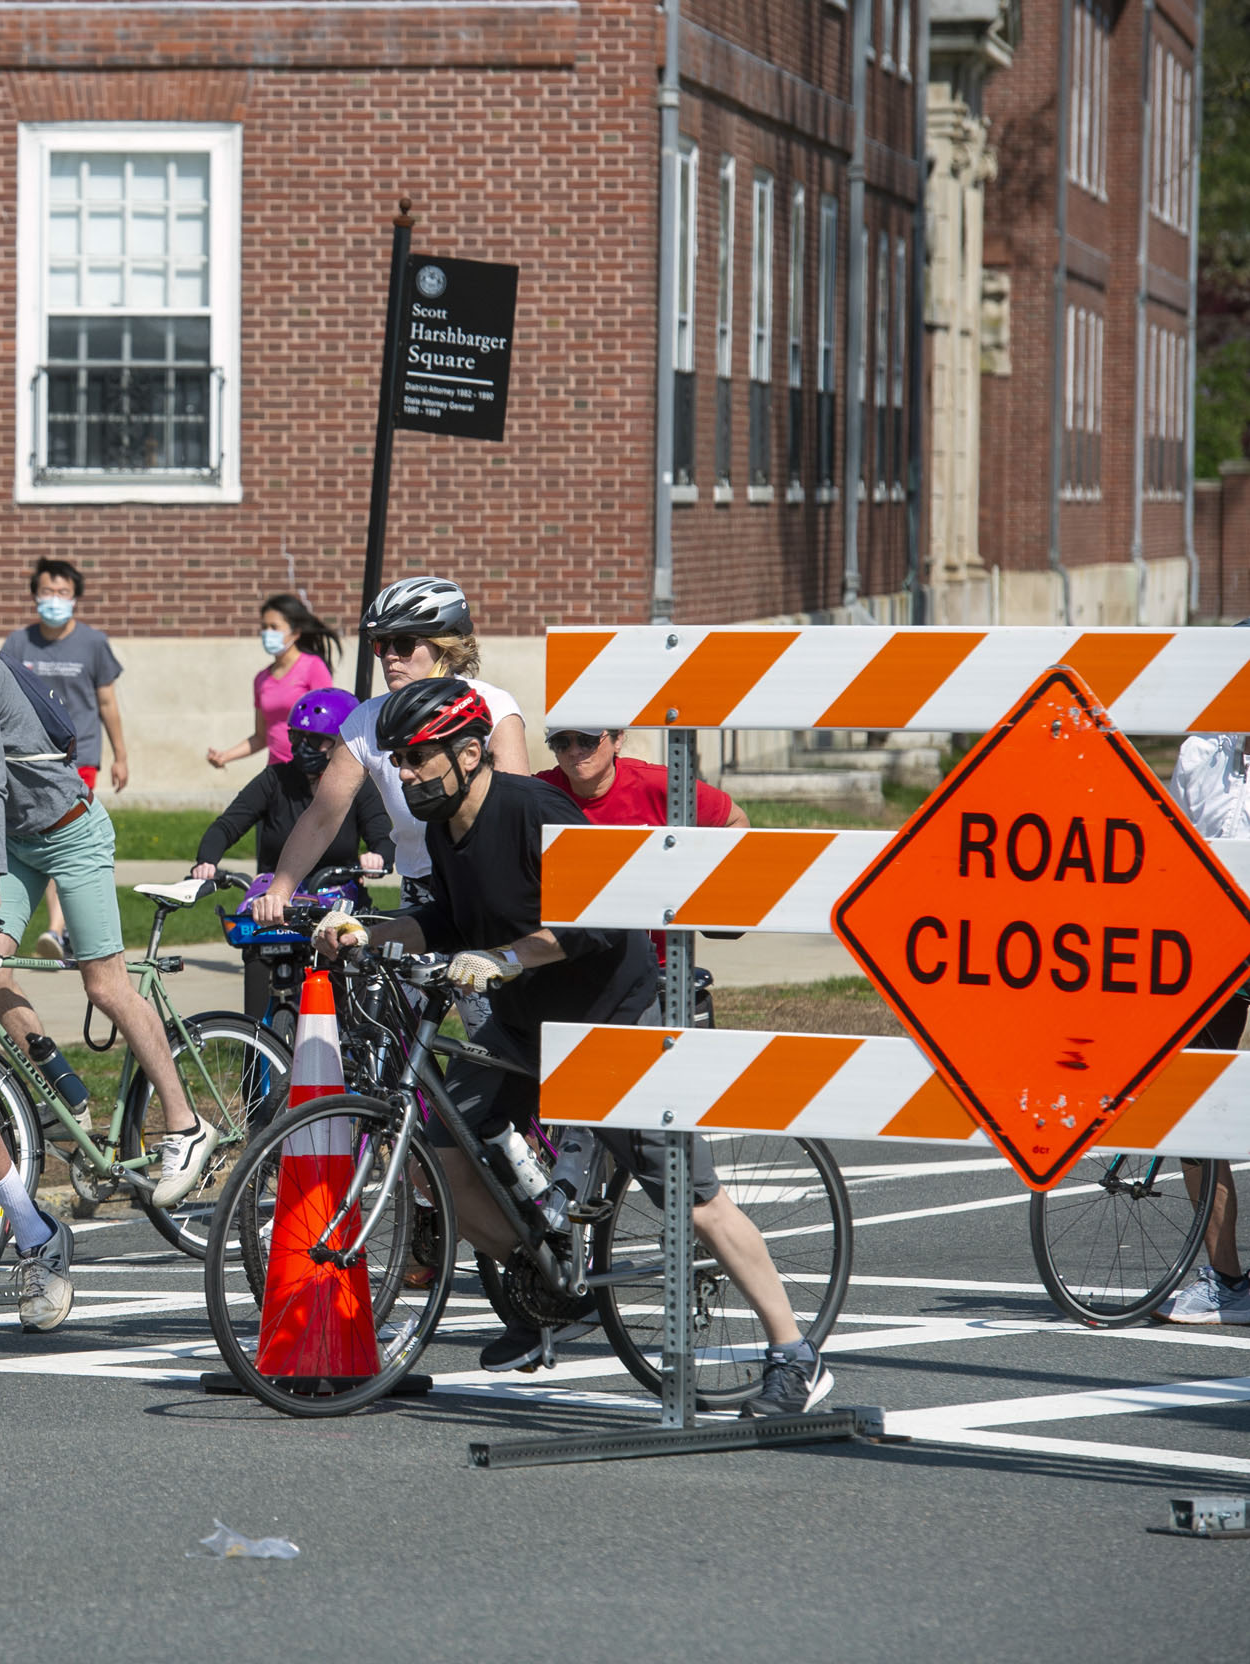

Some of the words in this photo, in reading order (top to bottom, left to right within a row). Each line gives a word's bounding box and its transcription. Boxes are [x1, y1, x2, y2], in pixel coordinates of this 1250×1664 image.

[411, 302, 448, 320] Scott
[407, 344, 476, 370] Square
[410, 321, 507, 354] Harshbarger
[958, 812, 1145, 885] ROAD
[905, 915, 1193, 996] CLOSED
[3, 1034, 57, 1102] Bianchi
